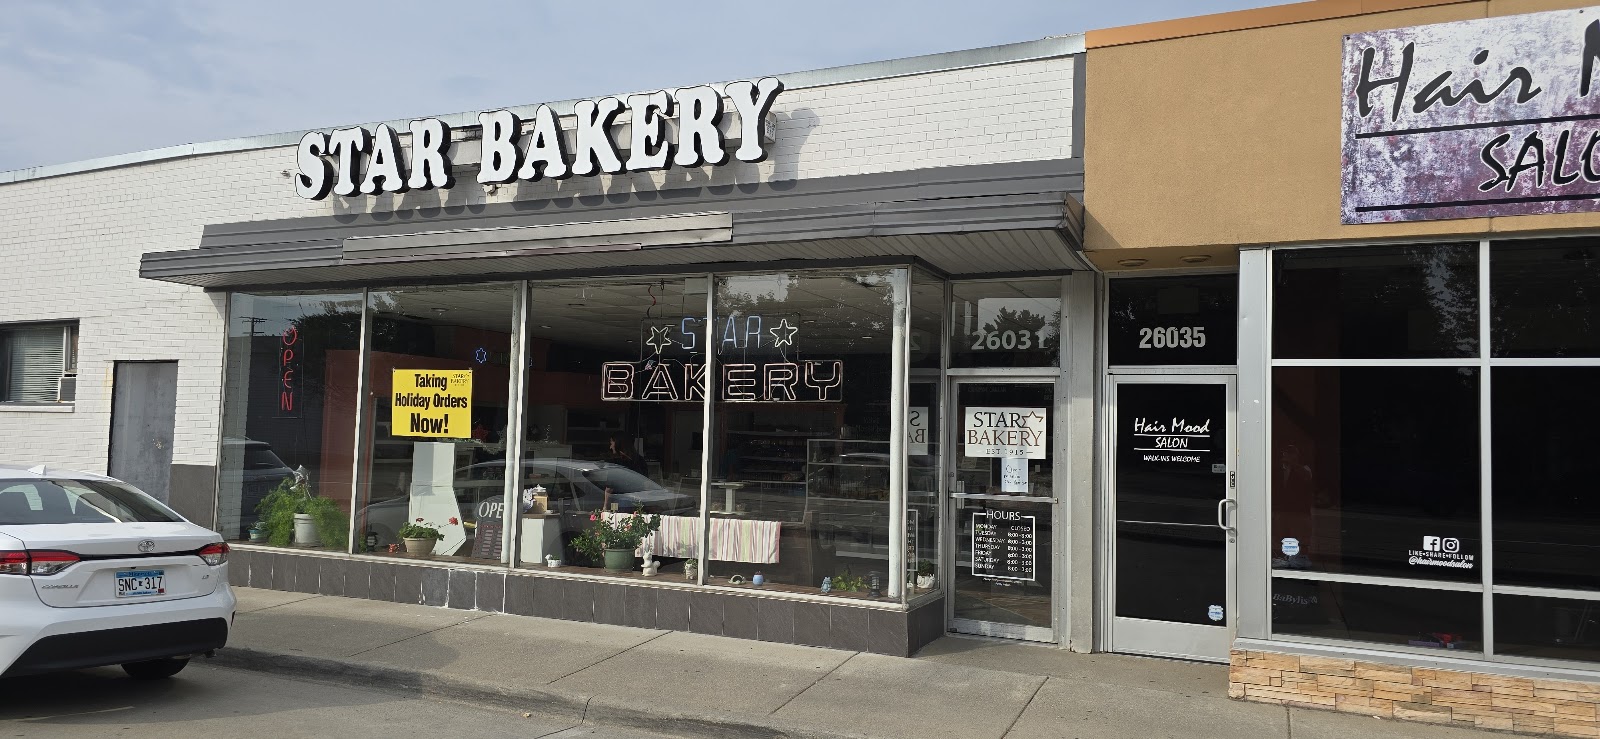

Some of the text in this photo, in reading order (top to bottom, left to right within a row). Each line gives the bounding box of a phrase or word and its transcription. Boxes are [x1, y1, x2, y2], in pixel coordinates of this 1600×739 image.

[1356, 42, 1542, 122] Hair
[295, 76, 784, 200] STAR BAKERY
[971, 329, 1048, 350] 26031
[1139, 326, 1206, 348] 26035
[281, 325, 298, 411] OPEN
[414, 373, 448, 391] Taking
[603, 361, 842, 400] BAKERY
[395, 392, 468, 410] Holiday Orders
[410, 412, 449, 434] Now!
[973, 411, 1022, 428] STAR
[1134, 417, 1210, 433] Hair Mood
[967, 429, 1043, 446] BAKERY
[1155, 437, 1188, 448] SALON
[1143, 454, 1201, 463] WALK-INS WELCOME
[478, 501, 504, 518] OPE
[986, 510, 1021, 520] HOURS
[1409, 556, 1474, 569] @hairmoodsalon
[118, 576, 163, 592] SNC 317
